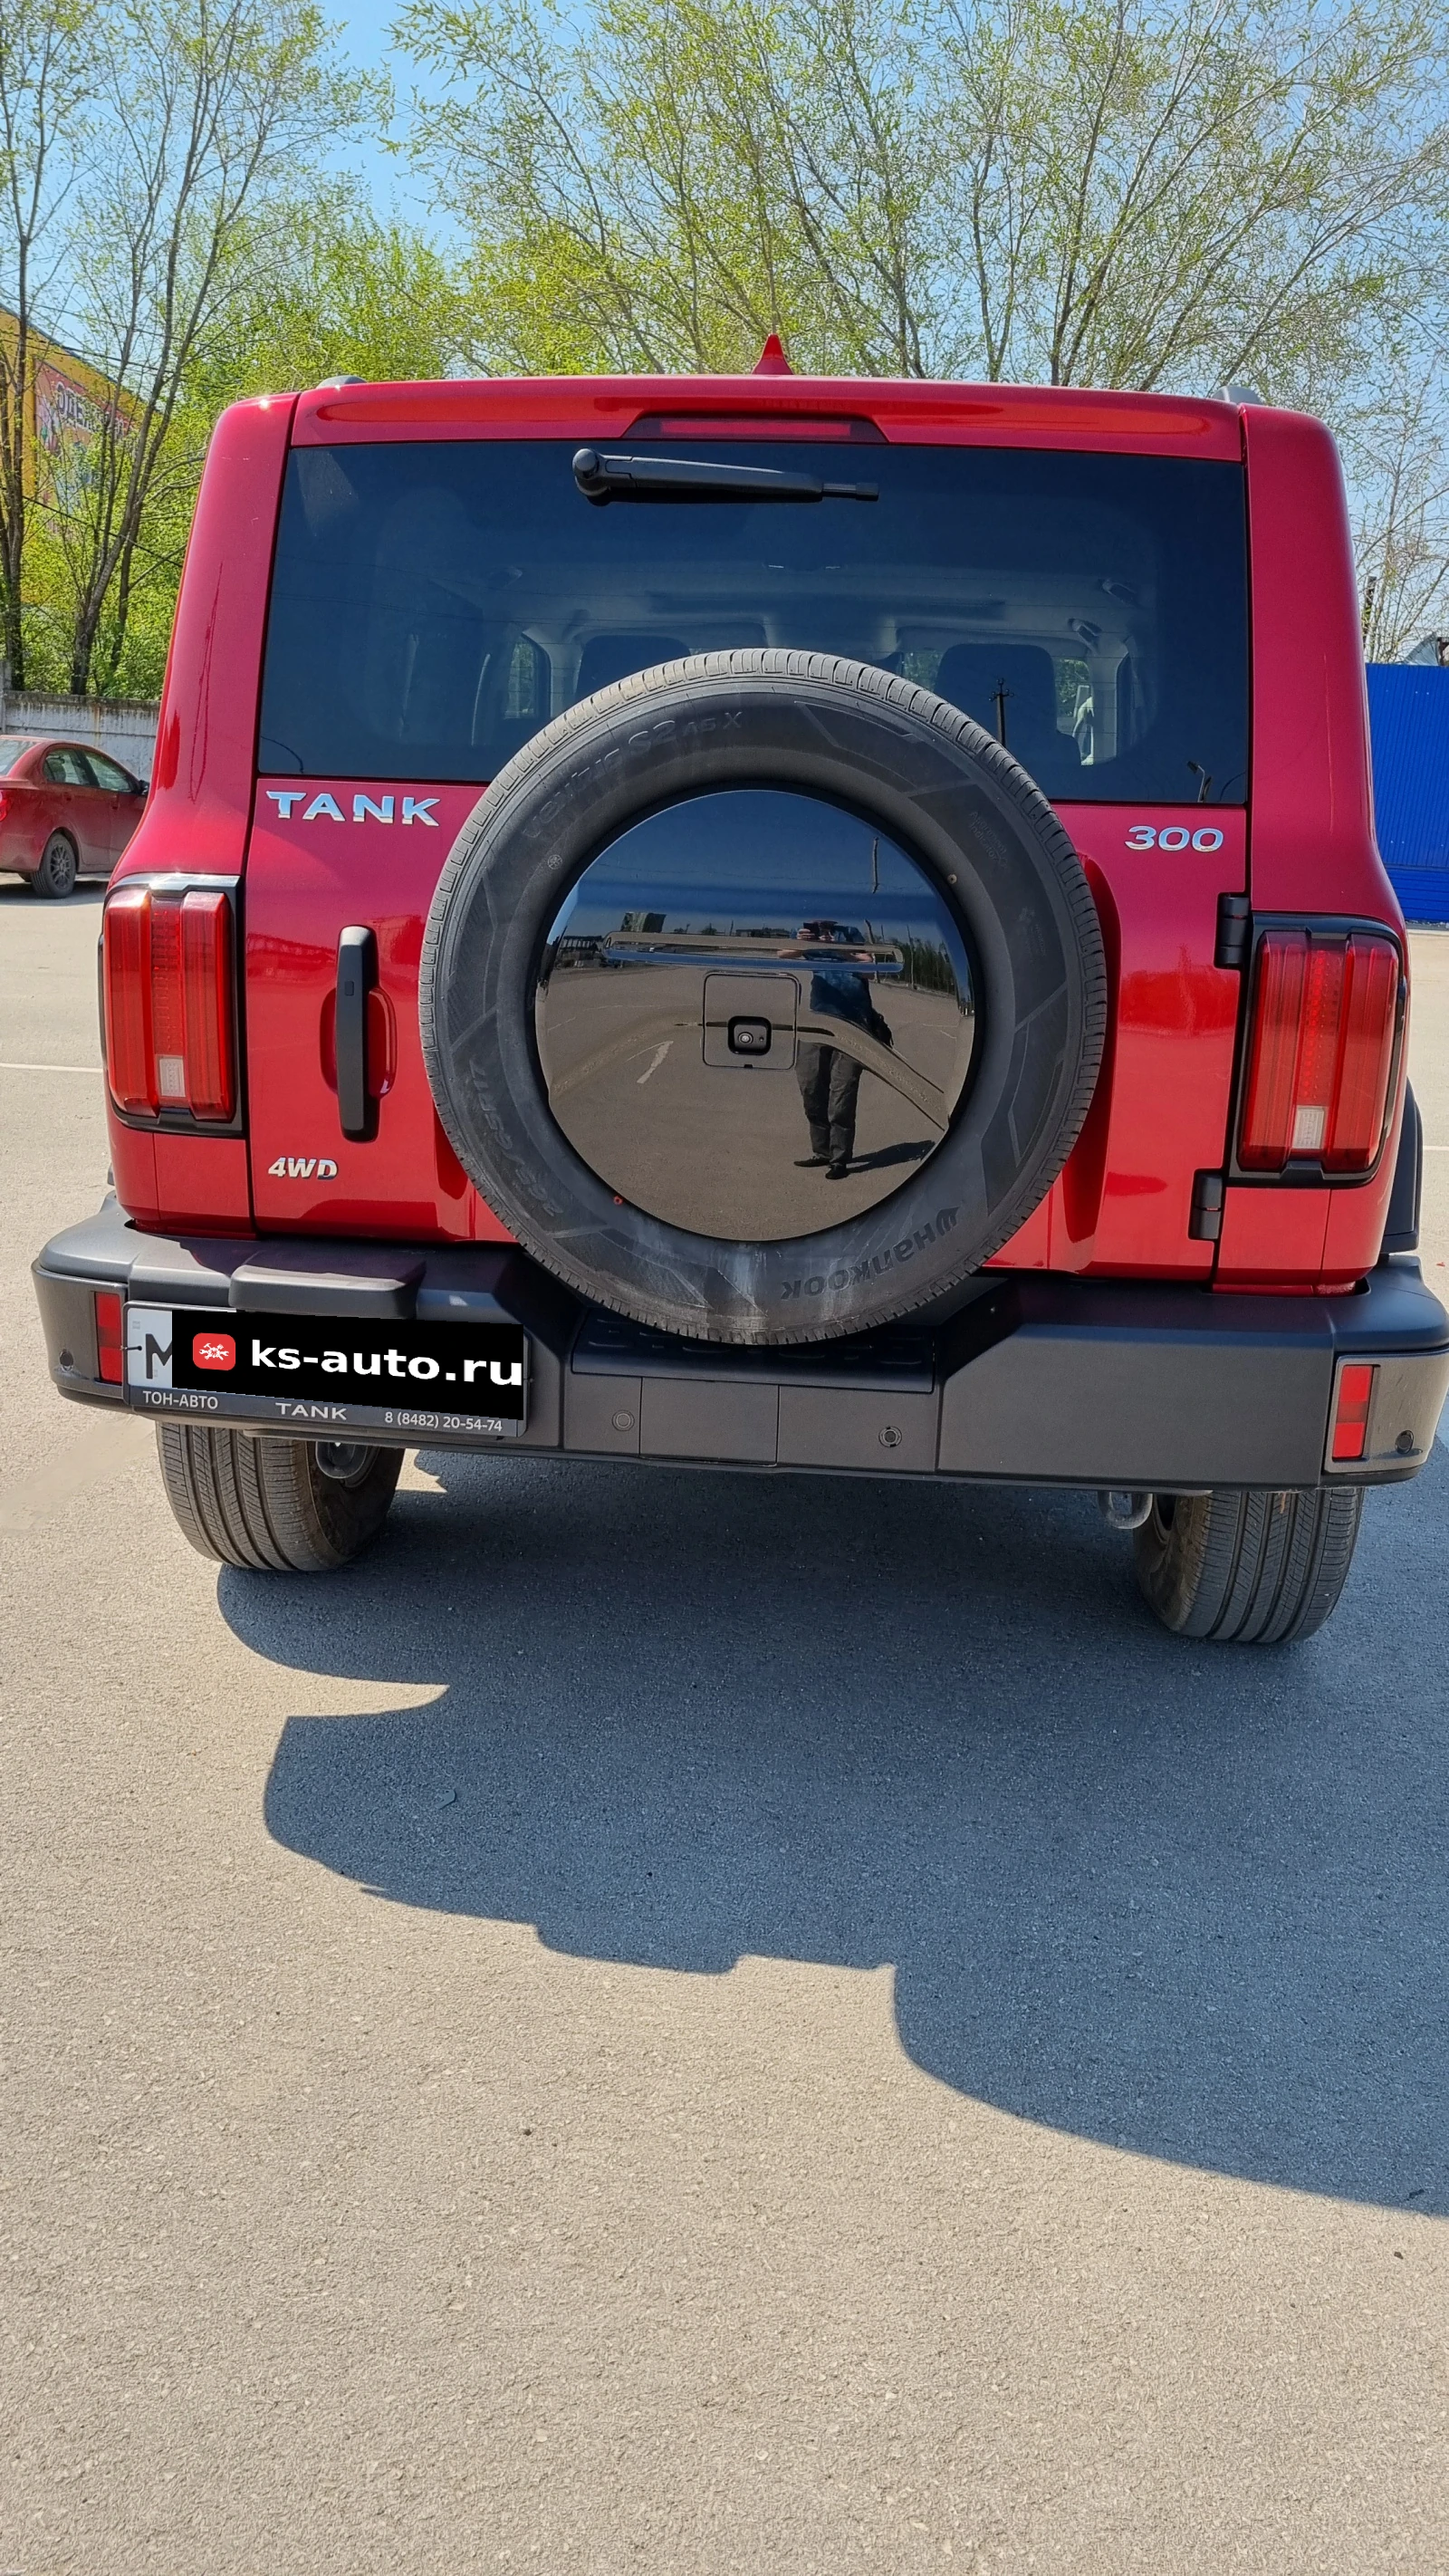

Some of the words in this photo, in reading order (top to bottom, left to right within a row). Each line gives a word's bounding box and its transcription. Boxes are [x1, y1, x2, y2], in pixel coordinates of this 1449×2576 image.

[265, 790, 441, 828] TANK
[1124, 825, 1224, 852] 300
[267, 1156, 339, 1180] 4WD
[142, 1389, 219, 1410] ТОН-АВТО
[274, 1401, 348, 1421] TANK
[384, 1410, 394, 1425] 8
[396, 1411, 440, 1429] (8482)
[442, 1415, 504, 1432] 20-54-74
